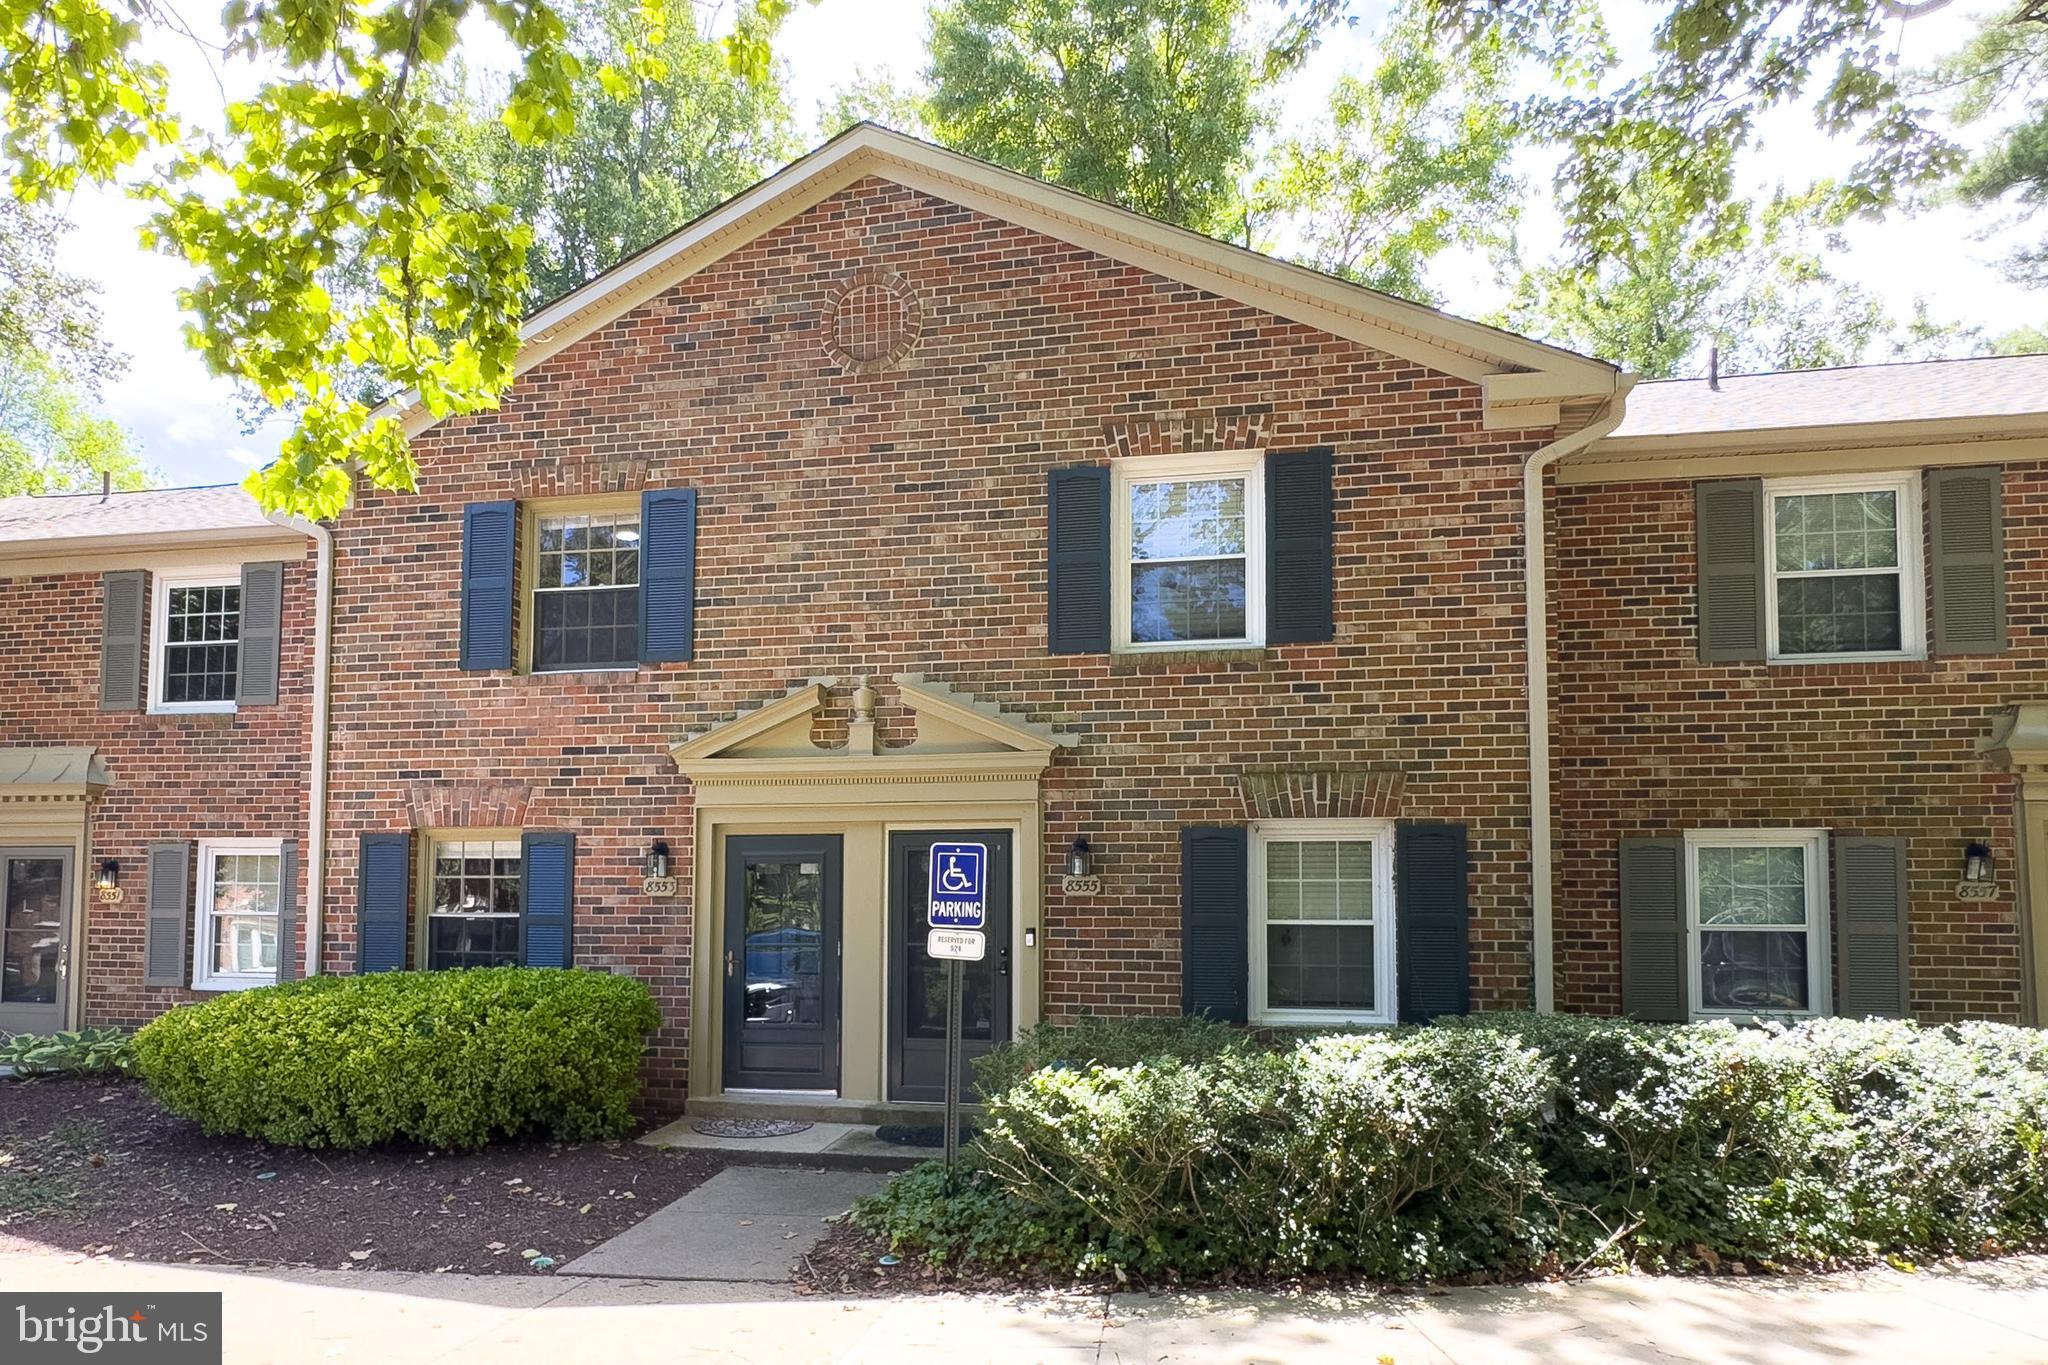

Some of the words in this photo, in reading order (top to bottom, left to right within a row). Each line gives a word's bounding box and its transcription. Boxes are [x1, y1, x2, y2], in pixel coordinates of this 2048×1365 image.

[646, 881, 676, 893] 8553
[1065, 880, 1099, 892] 8555
[1959, 885, 1998, 898] 8557
[932, 900, 981, 918] PARKING
[938, 936, 964, 944] RESERVED
[964, 937, 976, 945] FOR
